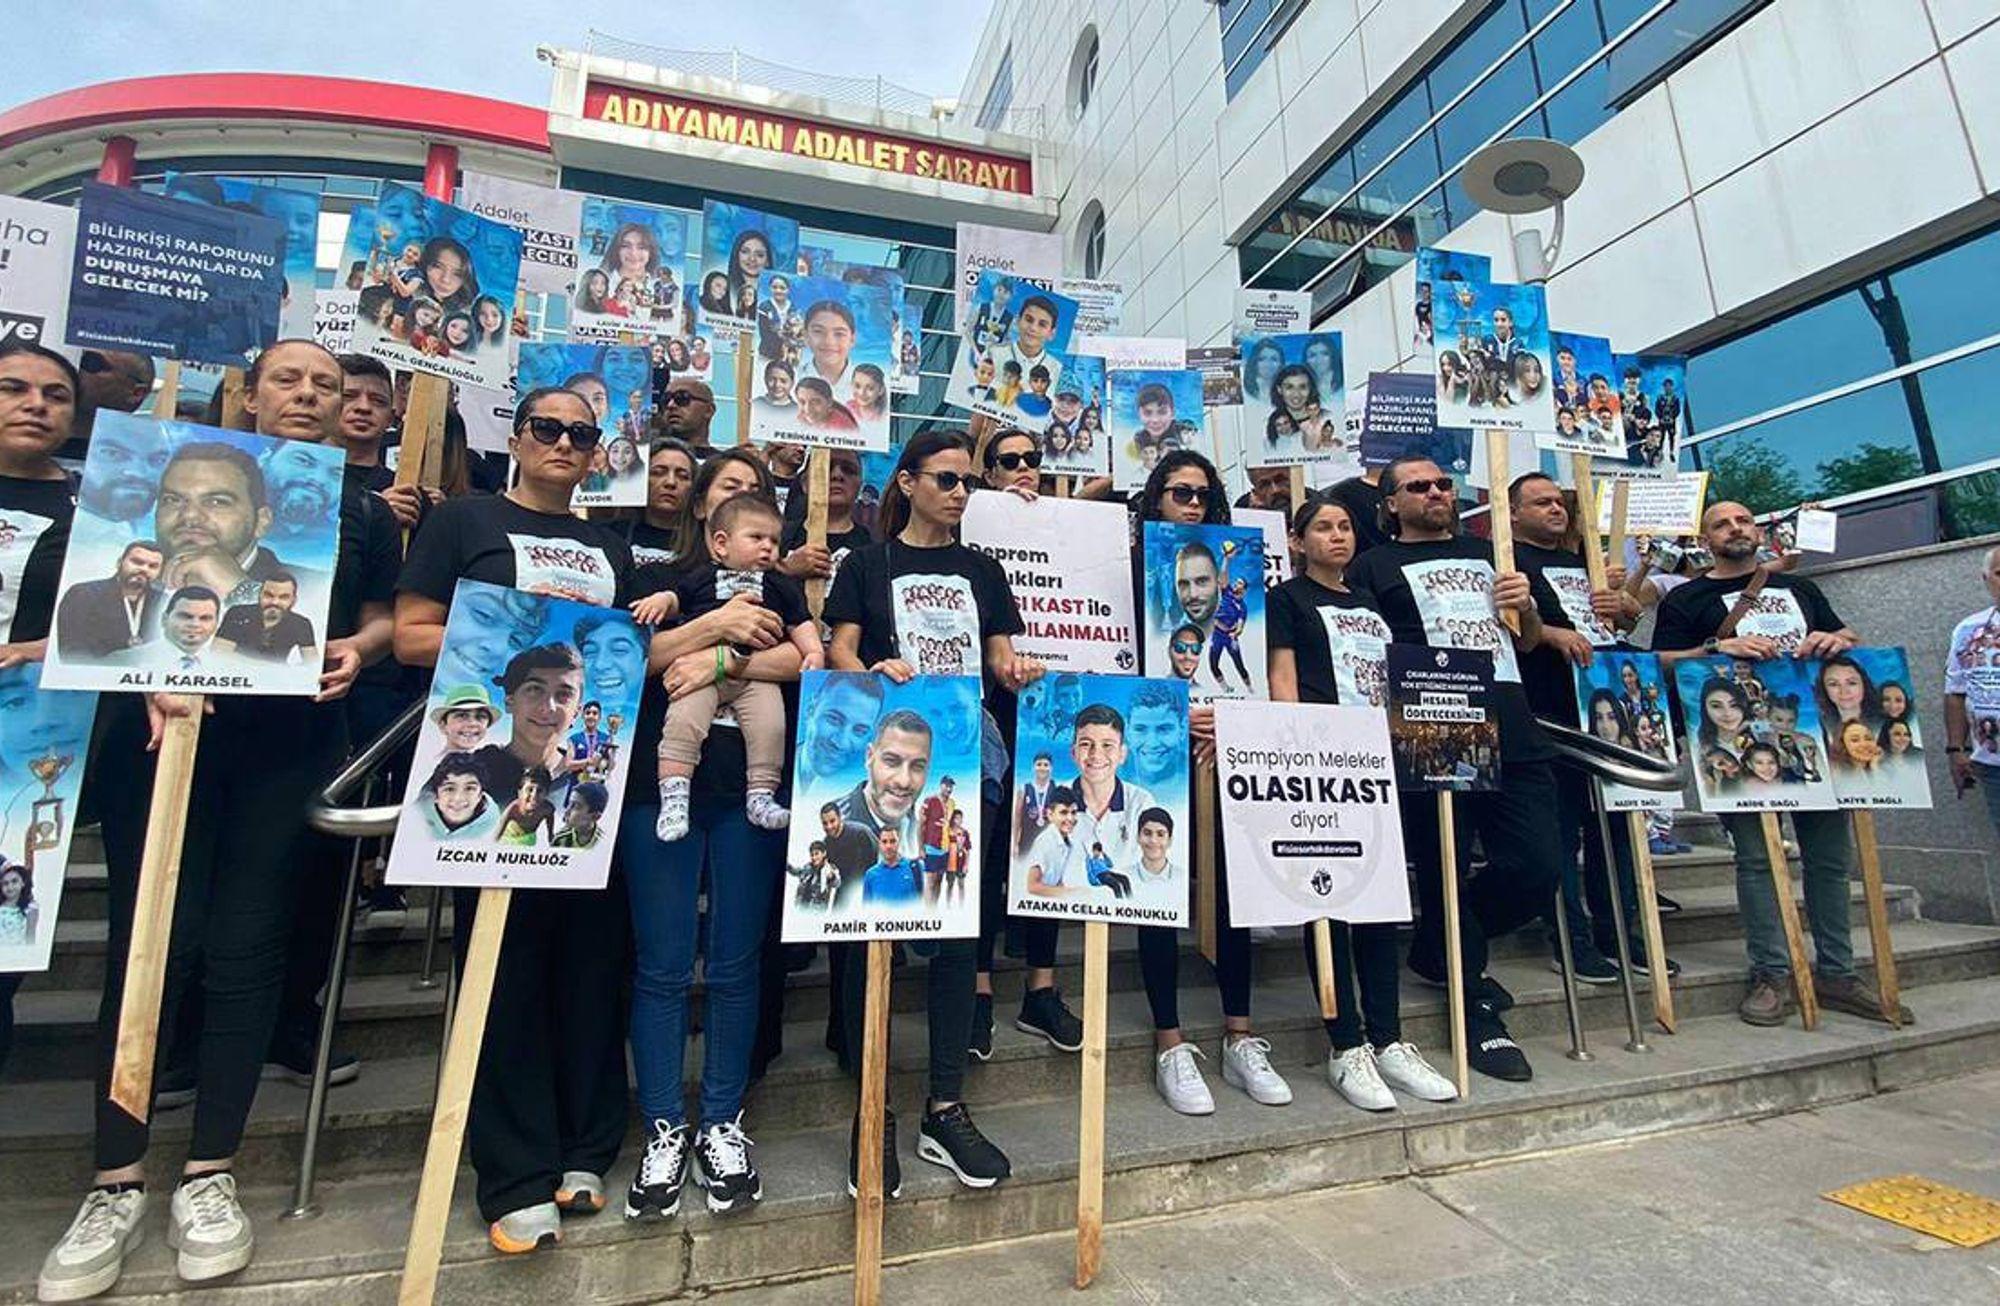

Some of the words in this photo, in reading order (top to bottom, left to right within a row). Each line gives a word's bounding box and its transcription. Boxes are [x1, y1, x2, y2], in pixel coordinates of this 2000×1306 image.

[602, 94, 784, 151] ADIYAMAN
[792, 129, 911, 174] ADALET
[914, 149, 1019, 192] SARAYI
[472, 202, 529, 225] Adalet
[0, 218, 50, 246] ha
[527, 230, 572, 249] KAST
[89, 222, 171, 249] BİLİRKİŞİ
[174, 237, 276, 267] RAPORUNU
[84, 255, 204, 286] DURUŞMAYA
[87, 238, 239, 276] HAZIRLAYANLAR
[239, 266, 264, 280] DA
[966, 254, 1016, 271] Adalet
[82, 272, 173, 298] GELECEK
[176, 285, 209, 302] Mİ?
[0, 318, 39, 341] ye
[371, 345, 408, 363] HAYAL
[409, 356, 485, 384] GENÇALİOĞLU
[774, 430, 818, 442] PERİHAN
[824, 436, 867, 447] ÇETİNER
[1368, 424, 1413, 434] GELECEK
[1008, 570, 1063, 589] ıkları
[1032, 597, 1085, 615] KAST
[1088, 598, 1112, 617] ile
[1027, 622, 1129, 643] ILANMALI!
[119, 672, 152, 686] ALİ
[164, 674, 253, 688] KARASEL
[1227, 747, 1315, 770] Şampiyon
[1319, 751, 1386, 769] Melekler
[1227, 774, 1313, 803] OLASI
[1318, 777, 1392, 804] KAST
[1837, 796, 1867, 805] LKİYE
[1872, 795, 1902, 805] DAĞLI
[1771, 798, 1799, 809] DAĞLI
[1290, 810, 1339, 833] diyor!
[436, 846, 488, 864] İZCAN
[495, 851, 571, 867] NURLUÖZ
[1017, 899, 1069, 914] ATAKAN
[1071, 902, 1112, 917] CELAL
[1114, 906, 1178, 922] KONUKLU
[823, 919, 867, 935] PAMİR
[874, 919, 941, 933] KONUKLU
